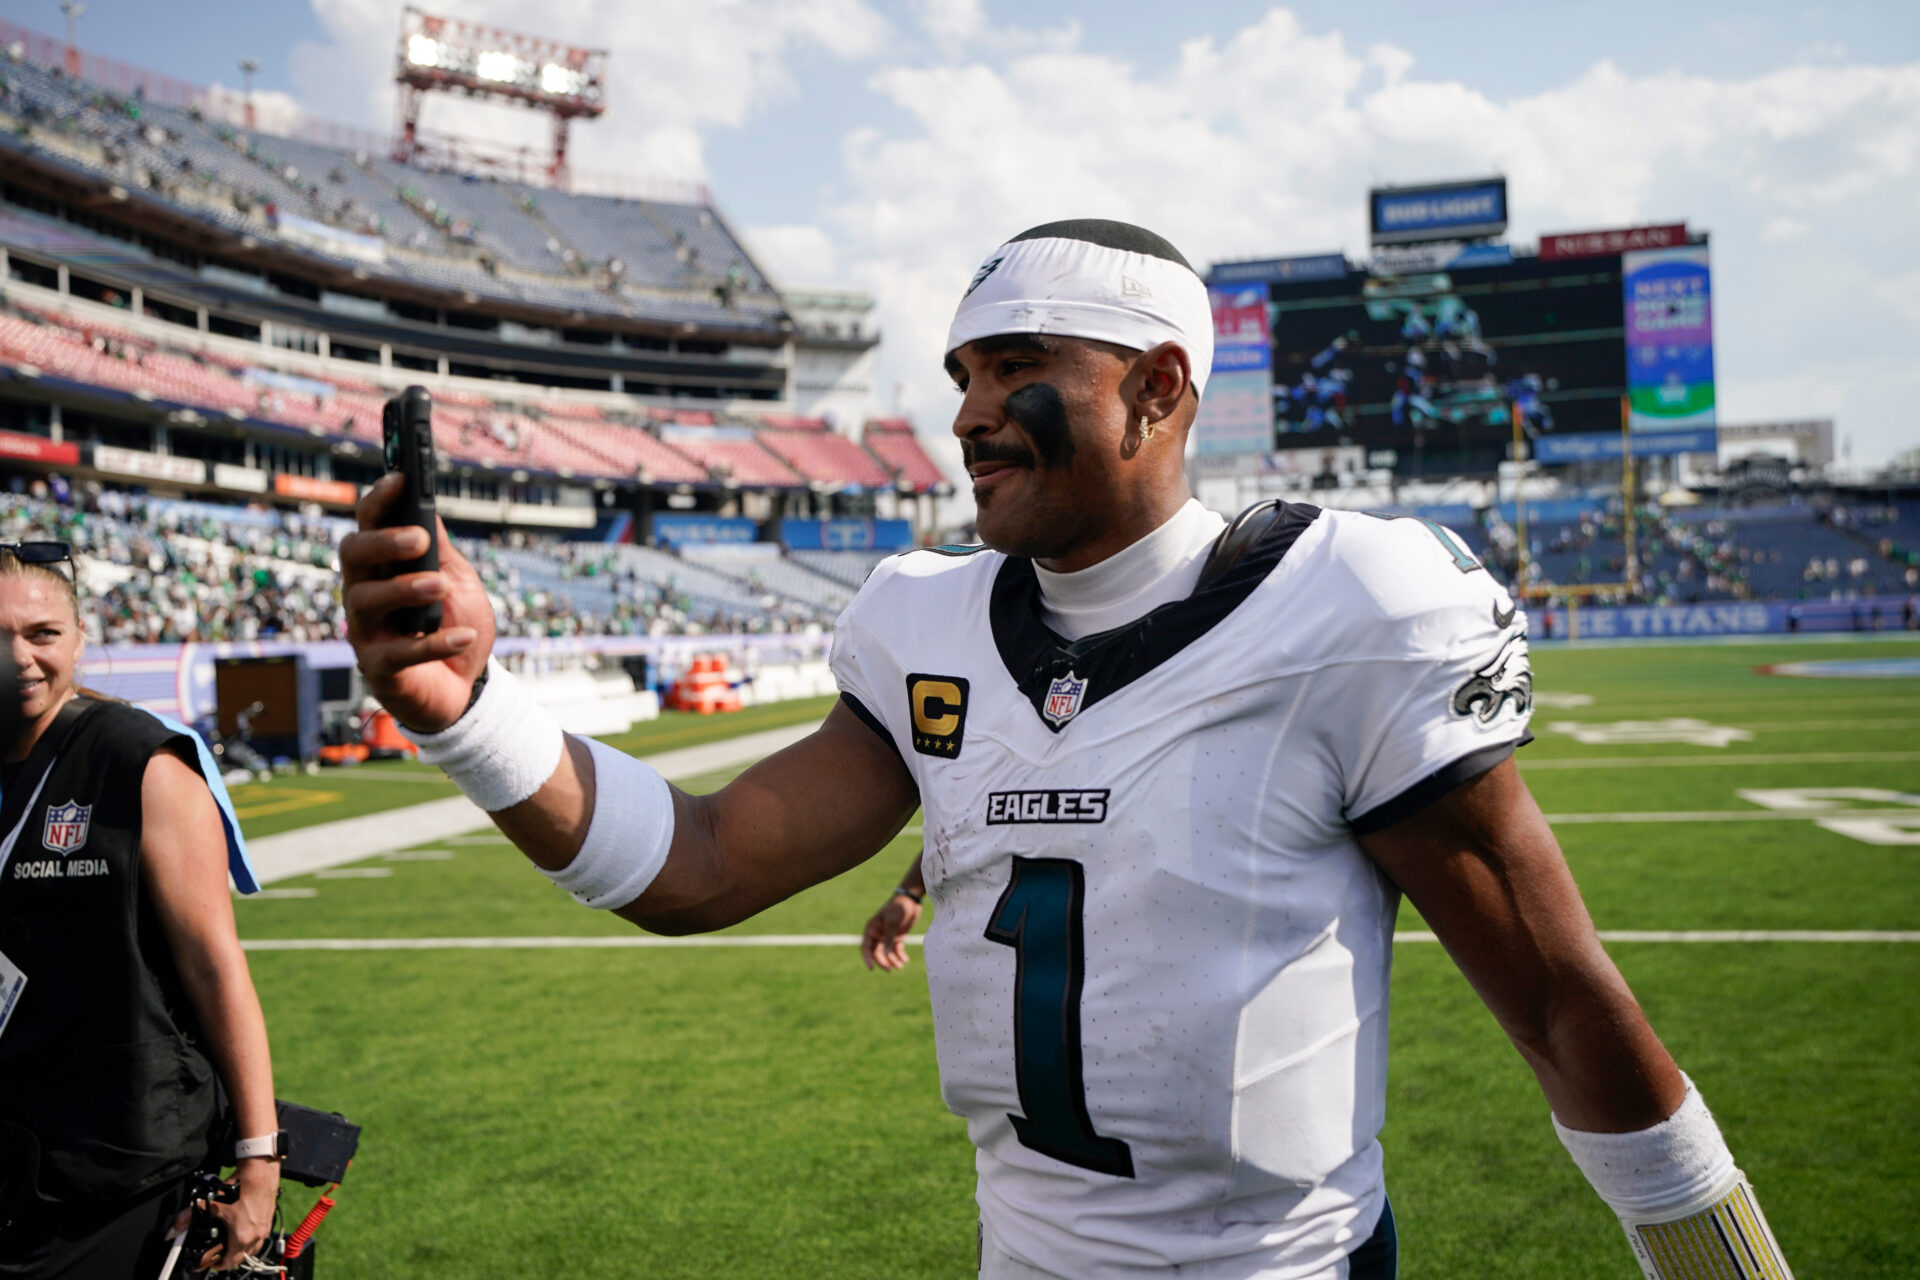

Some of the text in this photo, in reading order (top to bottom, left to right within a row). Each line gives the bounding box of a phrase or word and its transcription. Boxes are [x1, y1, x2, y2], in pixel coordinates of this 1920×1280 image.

[1382, 194, 1493, 224] BUD LIGHT
[1555, 230, 1672, 256] NISSAN
[1623, 603, 1769, 634] TITANS
[912, 680, 962, 737] C
[1048, 696, 1074, 716] NFL
[987, 790, 1109, 824] EAGLES
[49, 824, 82, 847] NFL
[14, 858, 110, 879] SOCIAL MEDIA
[983, 855, 1136, 1180] 1
